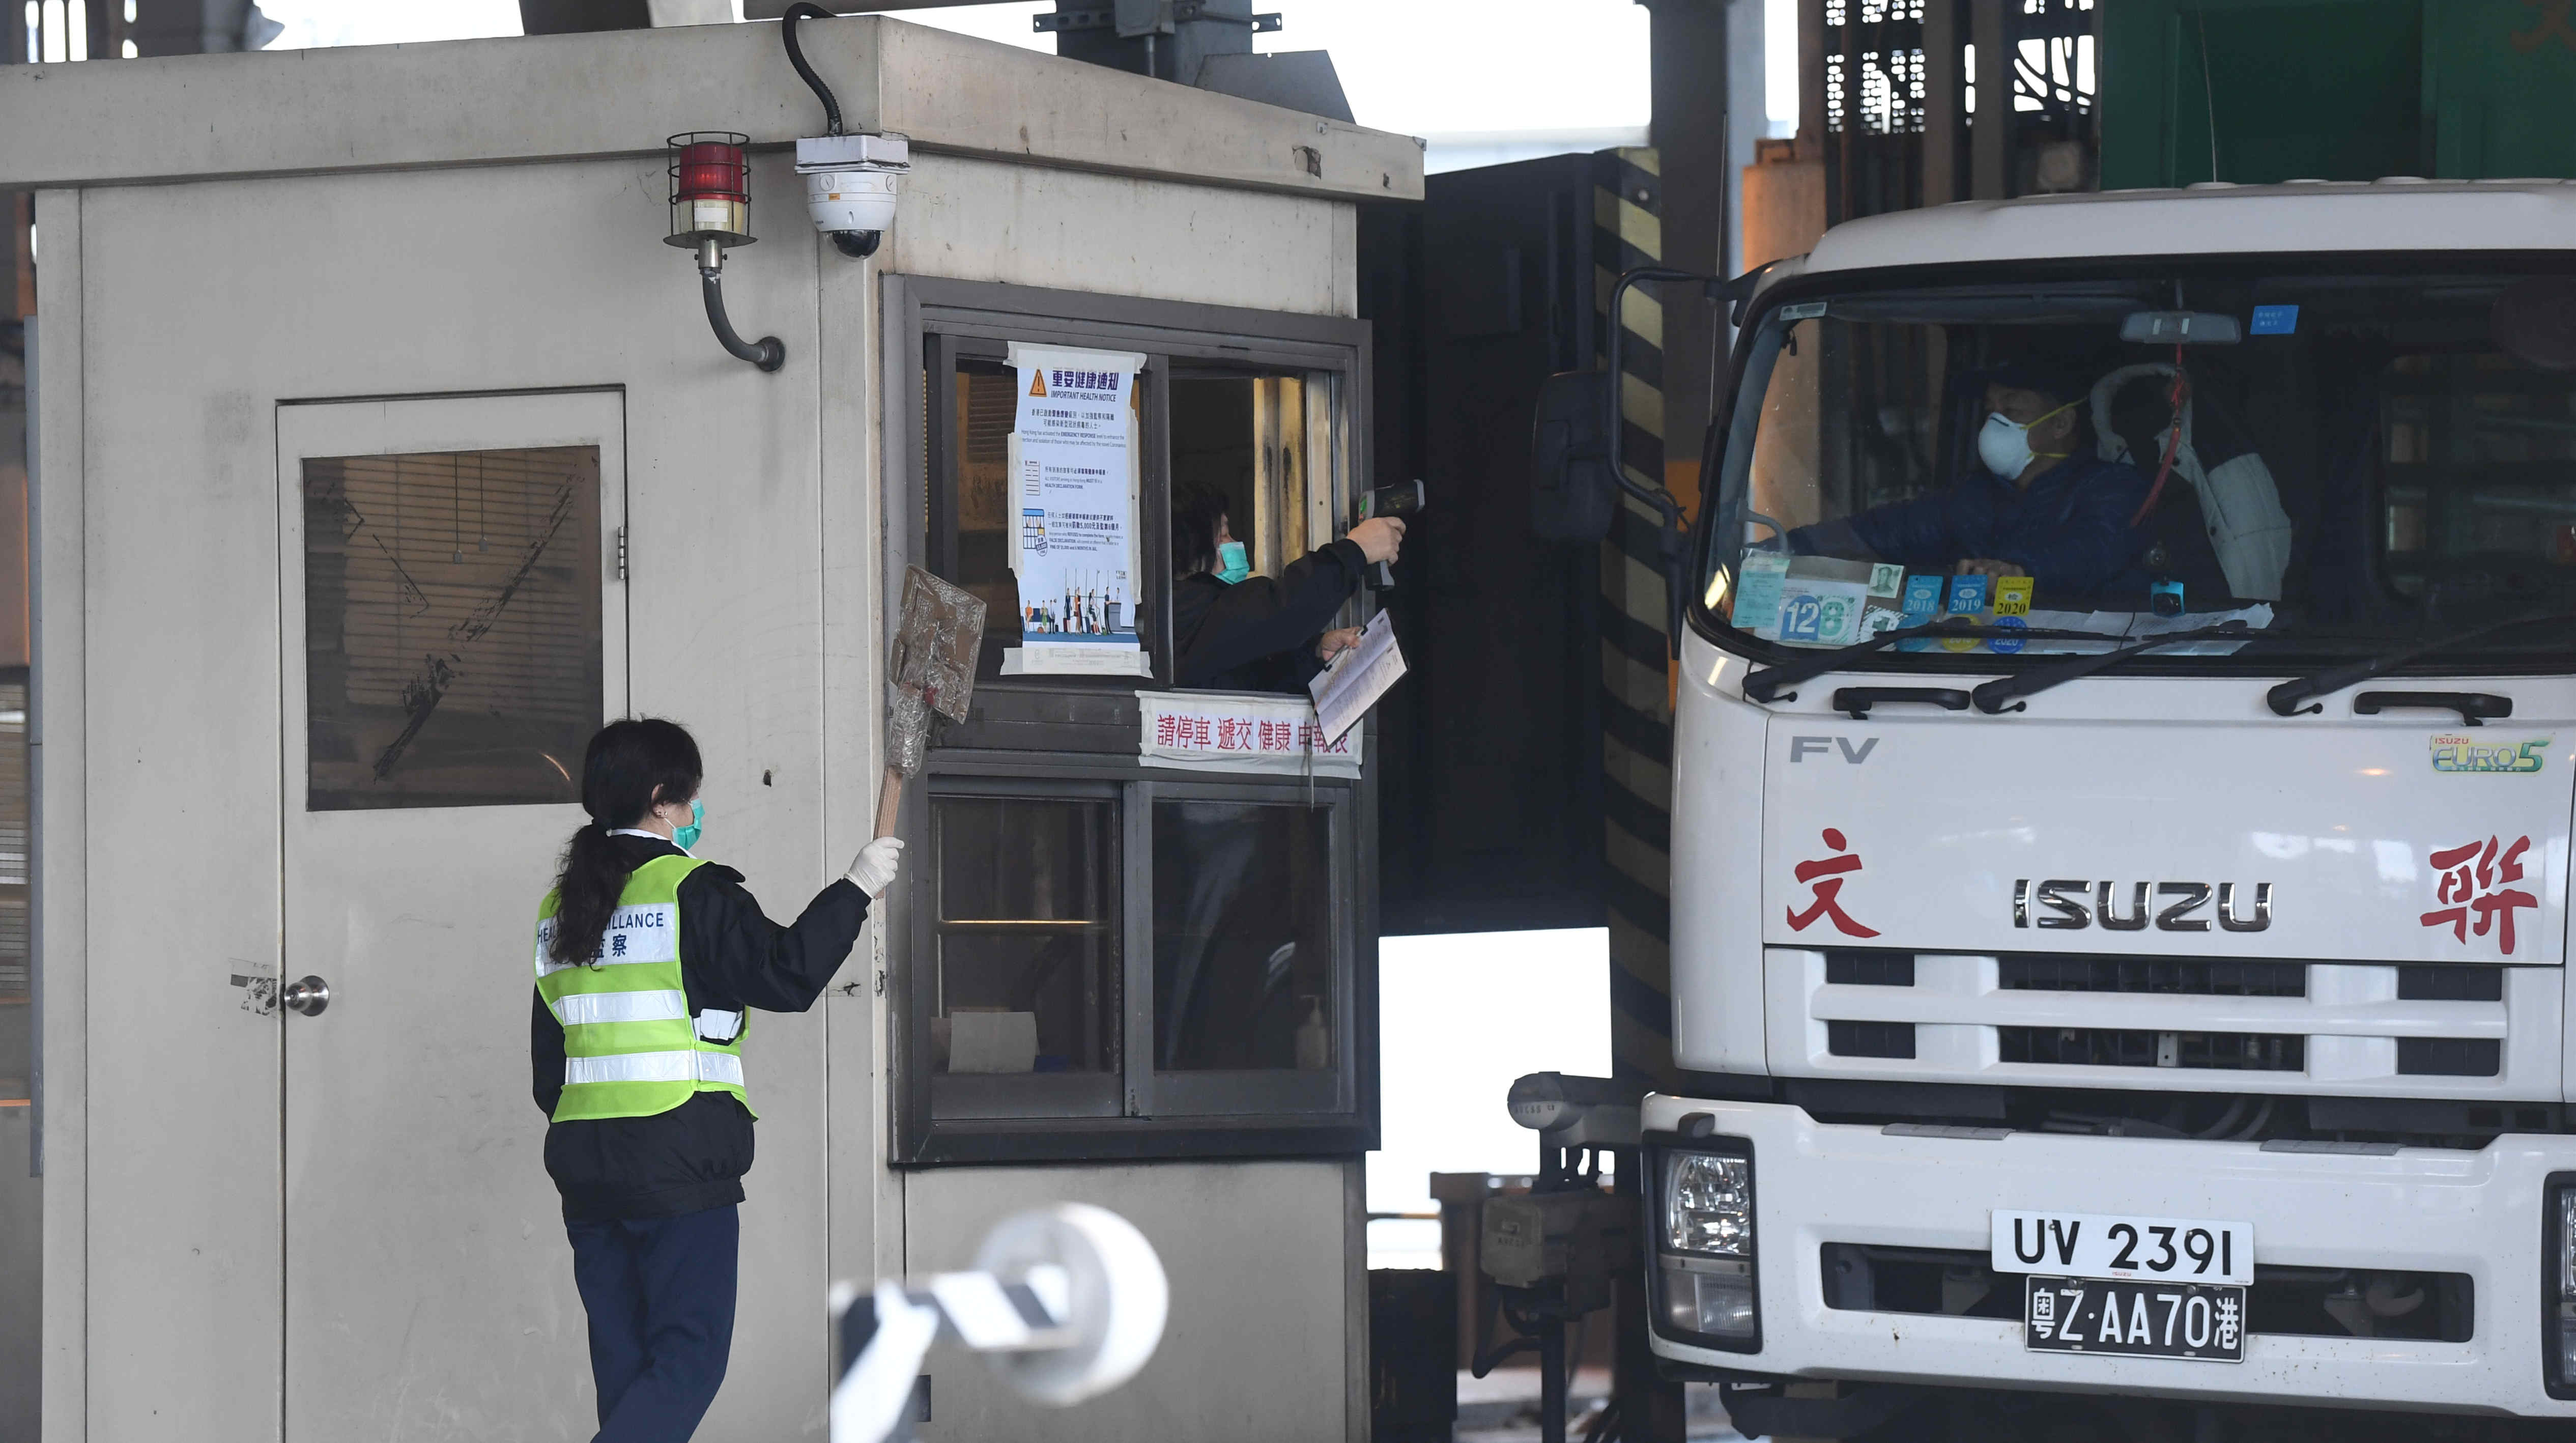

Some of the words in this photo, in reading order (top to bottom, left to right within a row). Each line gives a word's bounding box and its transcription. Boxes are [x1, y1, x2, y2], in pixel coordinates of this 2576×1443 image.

[1052, 370, 1119, 390] 重要健康通知
[1051, 390, 1079, 400] IMPORTANT
[1080, 392, 1098, 401] HEALTH
[1098, 393, 1116, 402] NOTICE
[1786, 602, 1820, 633] 12
[1906, 599, 1934, 612] 2018
[1951, 599, 1981, 612] 2019
[1997, 603, 2026, 614] 2020
[1158, 714, 1211, 750] 請停車
[1217, 717, 1252, 750] 遞交
[1258, 720, 1291, 751] 健康
[1790, 736, 1880, 764] FV
[1787, 828, 1882, 938] 文
[2014, 879, 2274, 932] ISUZU
[2014, 1218, 2080, 1265] UV
[2107, 1223, 2231, 1276] 2391
